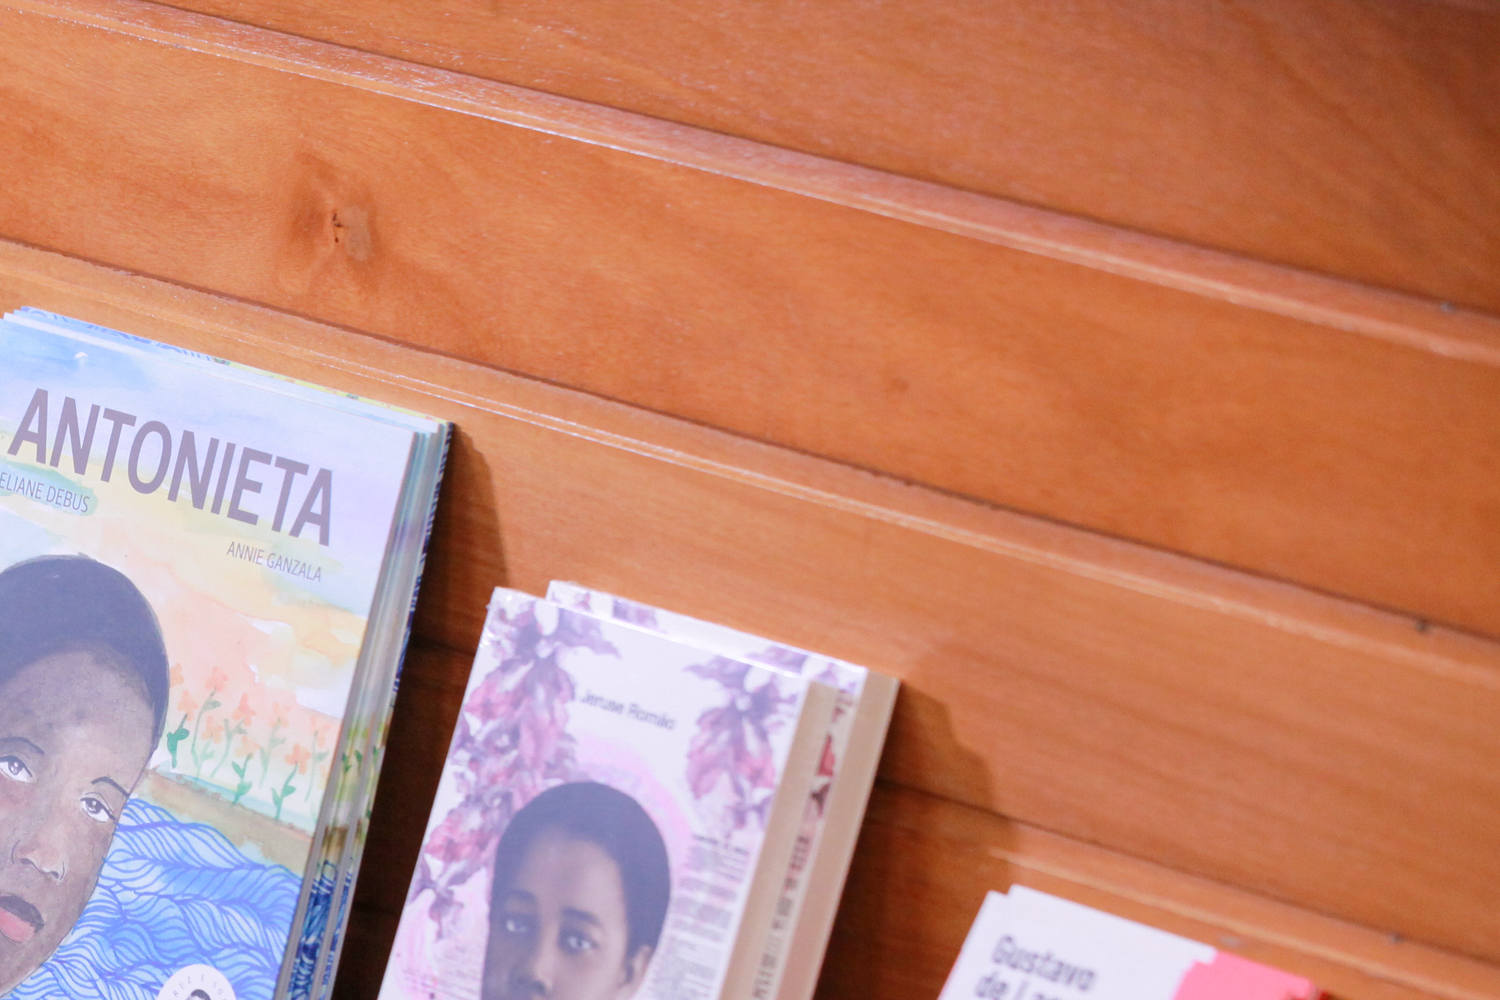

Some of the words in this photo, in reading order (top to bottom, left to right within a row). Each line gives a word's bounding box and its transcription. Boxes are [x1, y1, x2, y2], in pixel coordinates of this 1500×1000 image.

[7, 388, 333, 546] ANTONIETA
[46, 485, 90, 513] DEBUS
[226, 541, 265, 566] ANNIE
[266, 552, 321, 582] GANZALA
[992, 934, 1097, 992] Gustavo
